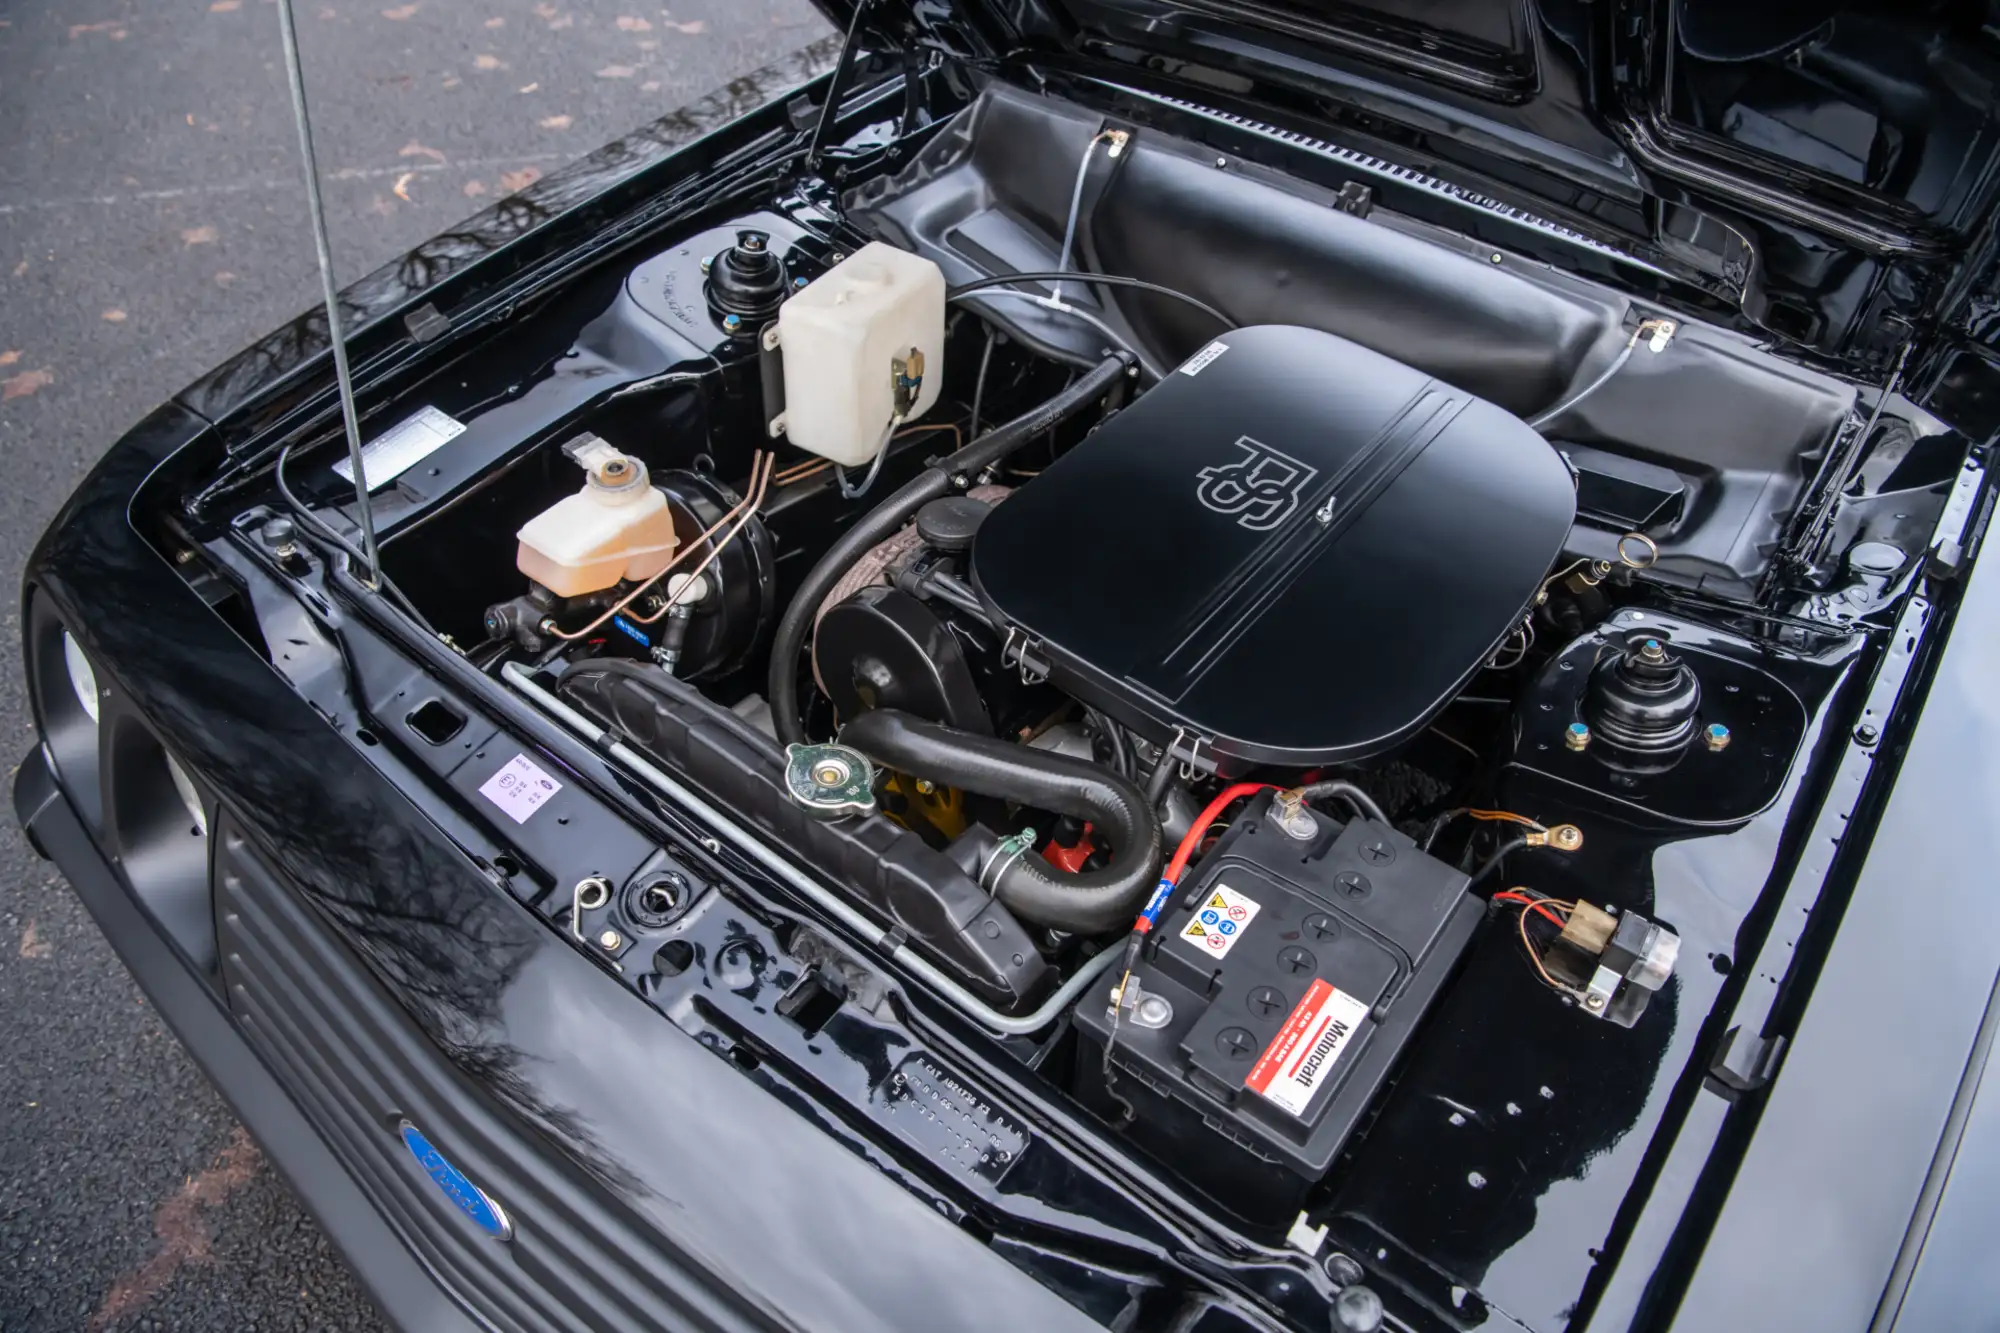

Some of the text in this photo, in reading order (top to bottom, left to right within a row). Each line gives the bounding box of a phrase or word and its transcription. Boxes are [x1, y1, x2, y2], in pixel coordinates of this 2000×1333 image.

[1196, 434, 1319, 531] RS
[1295, 1019, 1349, 1088] Motorcraft
[422, 1150, 480, 1215] Ford
